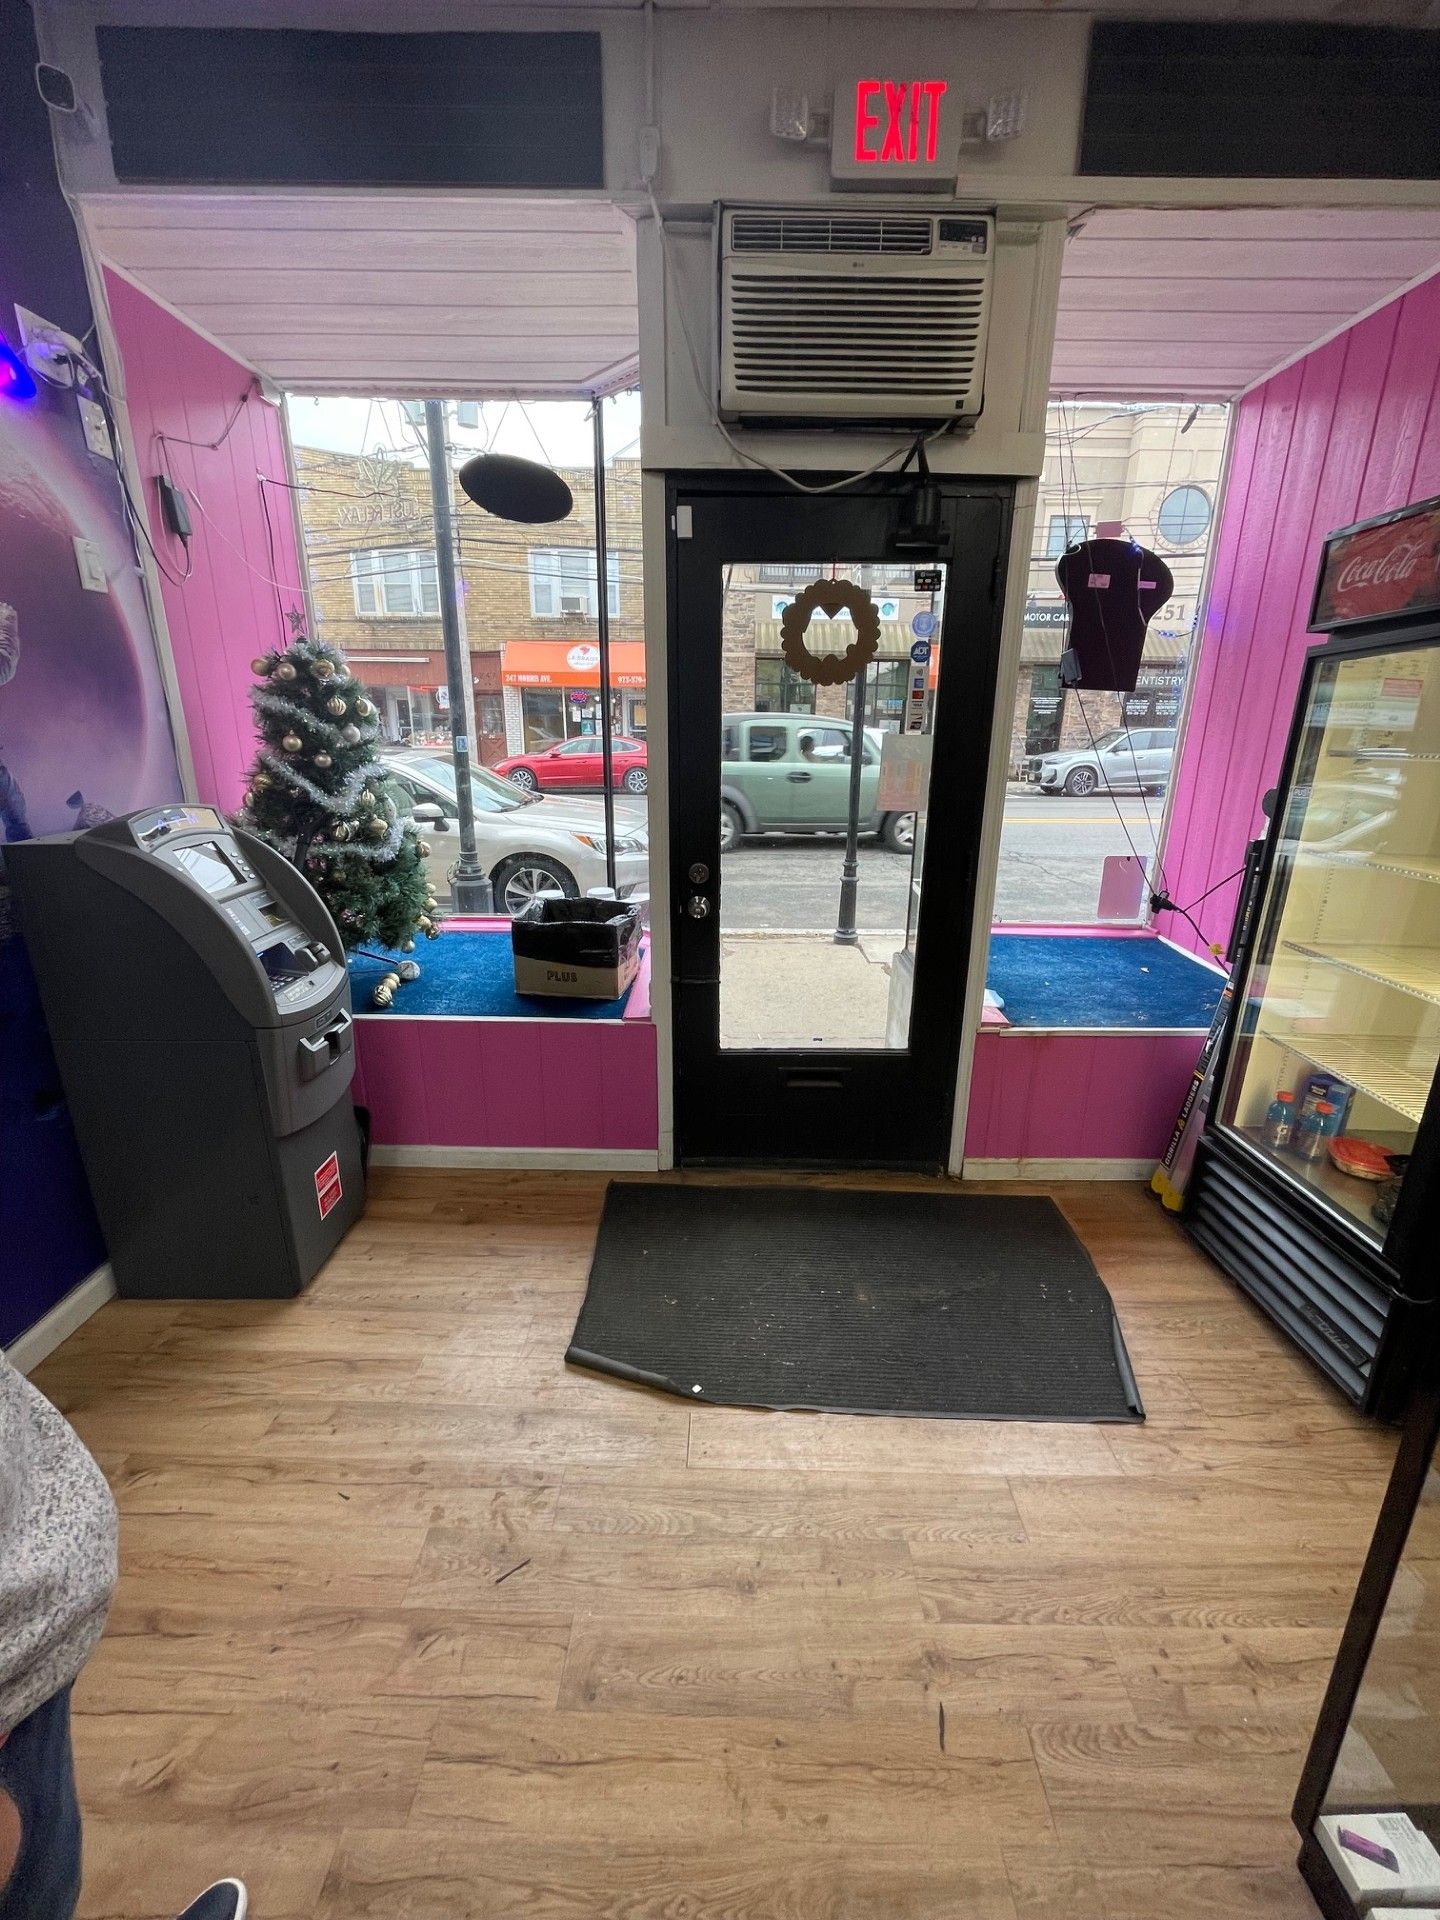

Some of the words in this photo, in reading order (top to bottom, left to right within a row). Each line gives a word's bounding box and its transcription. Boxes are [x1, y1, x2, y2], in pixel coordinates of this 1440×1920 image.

[855, 79, 948, 162] EXIT
[913, 646, 928, 655] ADT
[546, 968, 578, 983] PLUS
[1164, 1130, 1181, 1166] GORILLA
[1181, 1078, 1201, 1119] LADDERS
